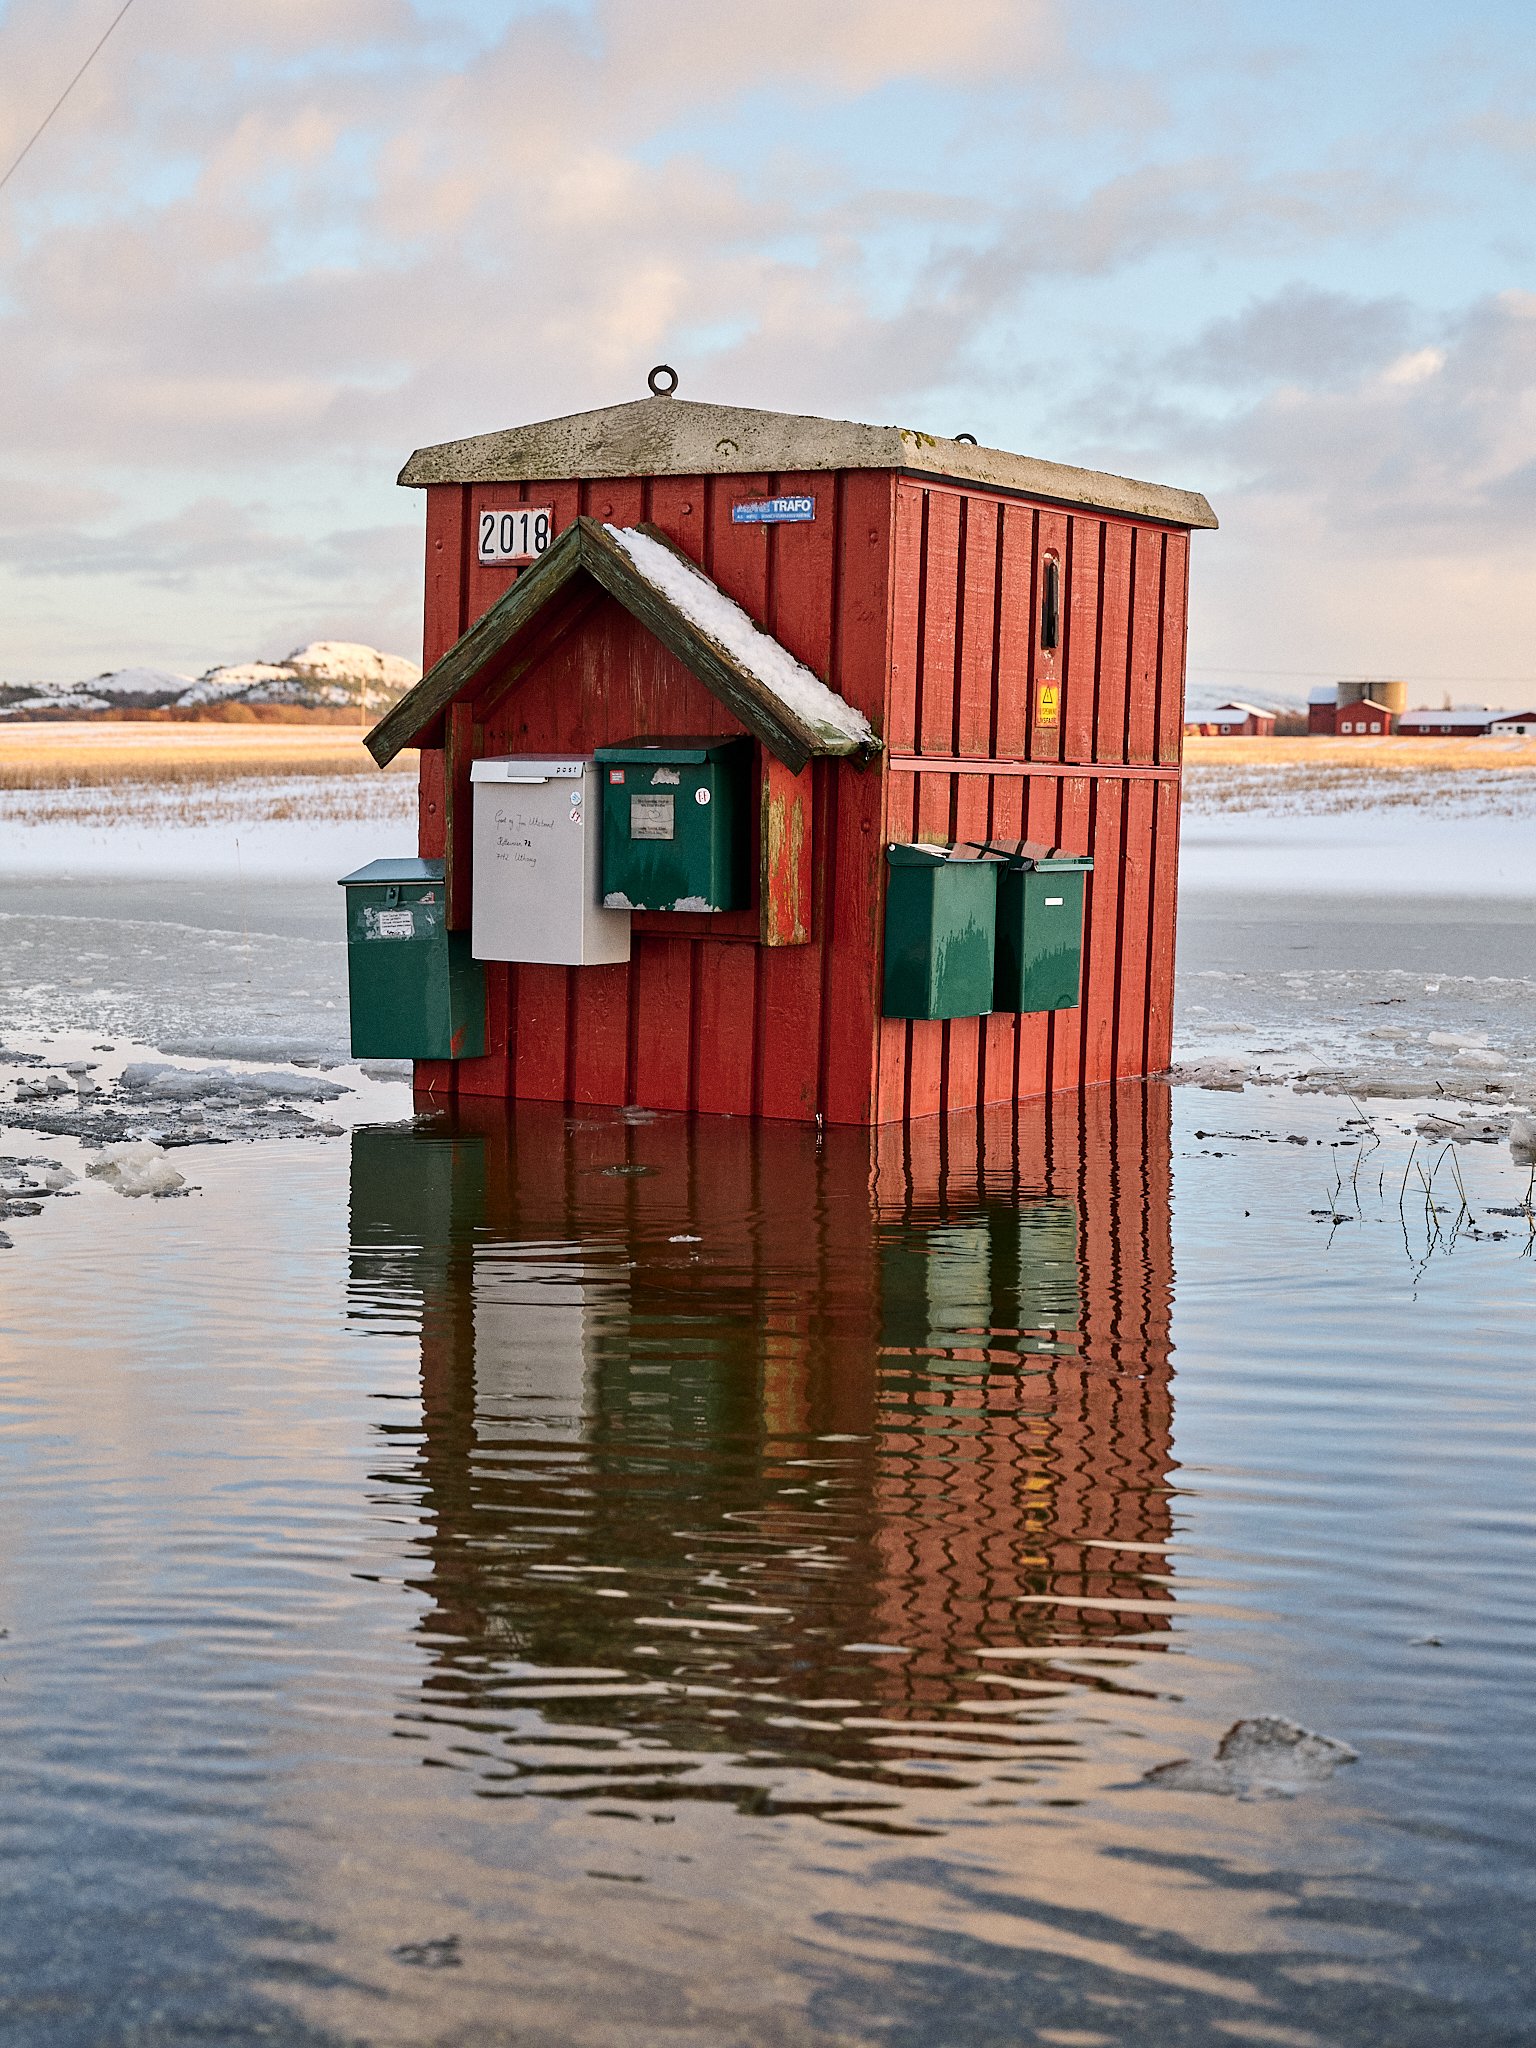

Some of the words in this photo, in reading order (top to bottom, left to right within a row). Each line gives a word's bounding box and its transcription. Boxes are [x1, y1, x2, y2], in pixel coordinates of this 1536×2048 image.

[772, 499, 811, 512] TRAFO
[482, 514, 548, 553] 2018
[556, 766, 577, 774] post
[524, 839, 532, 847] 72
